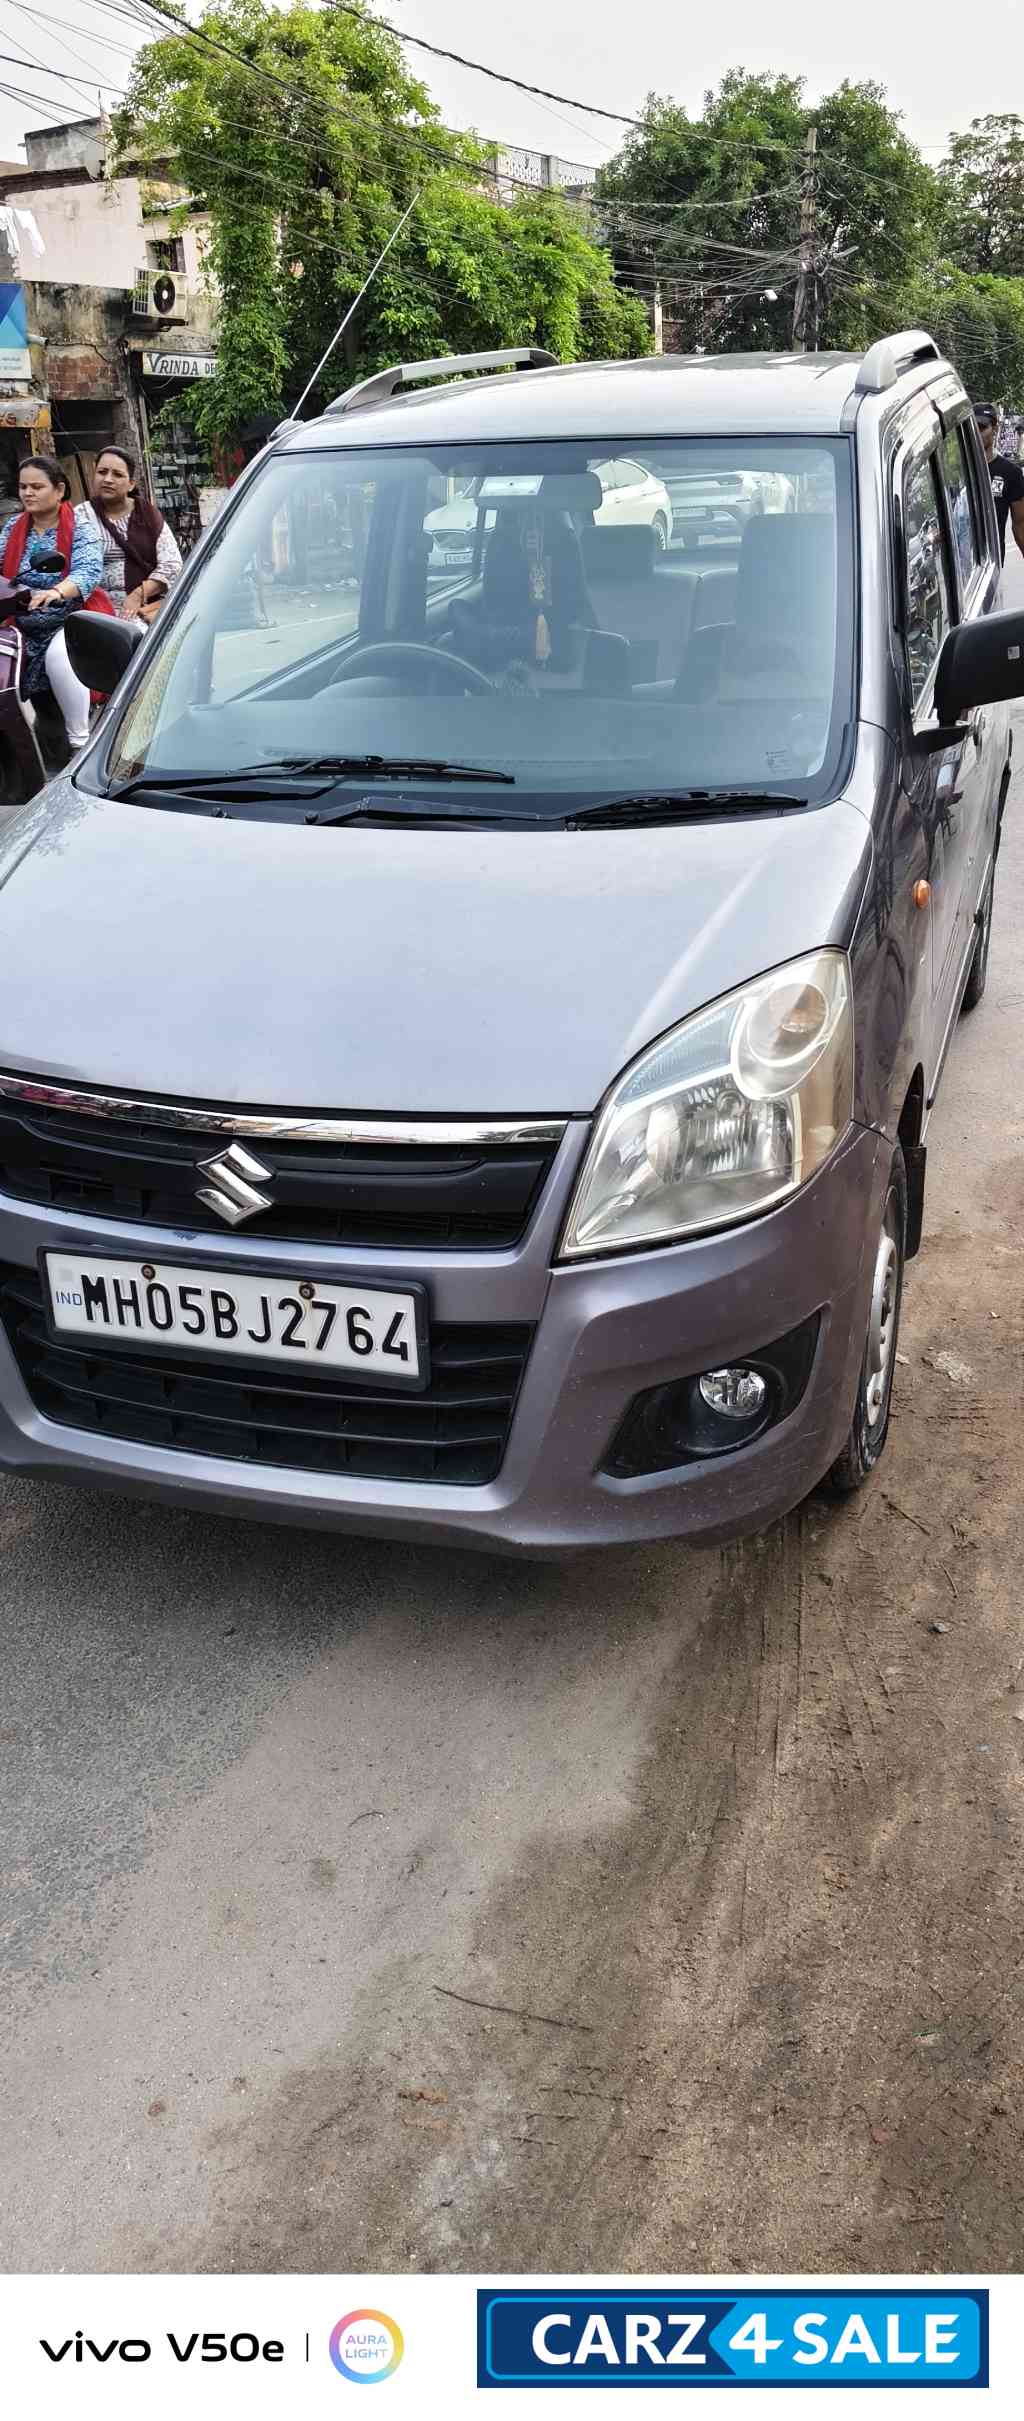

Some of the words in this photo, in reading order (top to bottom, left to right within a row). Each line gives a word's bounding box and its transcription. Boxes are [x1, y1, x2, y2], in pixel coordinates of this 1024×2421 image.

[147, 353, 199, 376] VRINDA
[55, 1291, 82, 1306] IND
[81, 1274, 409, 1361] MH05BJ2764
